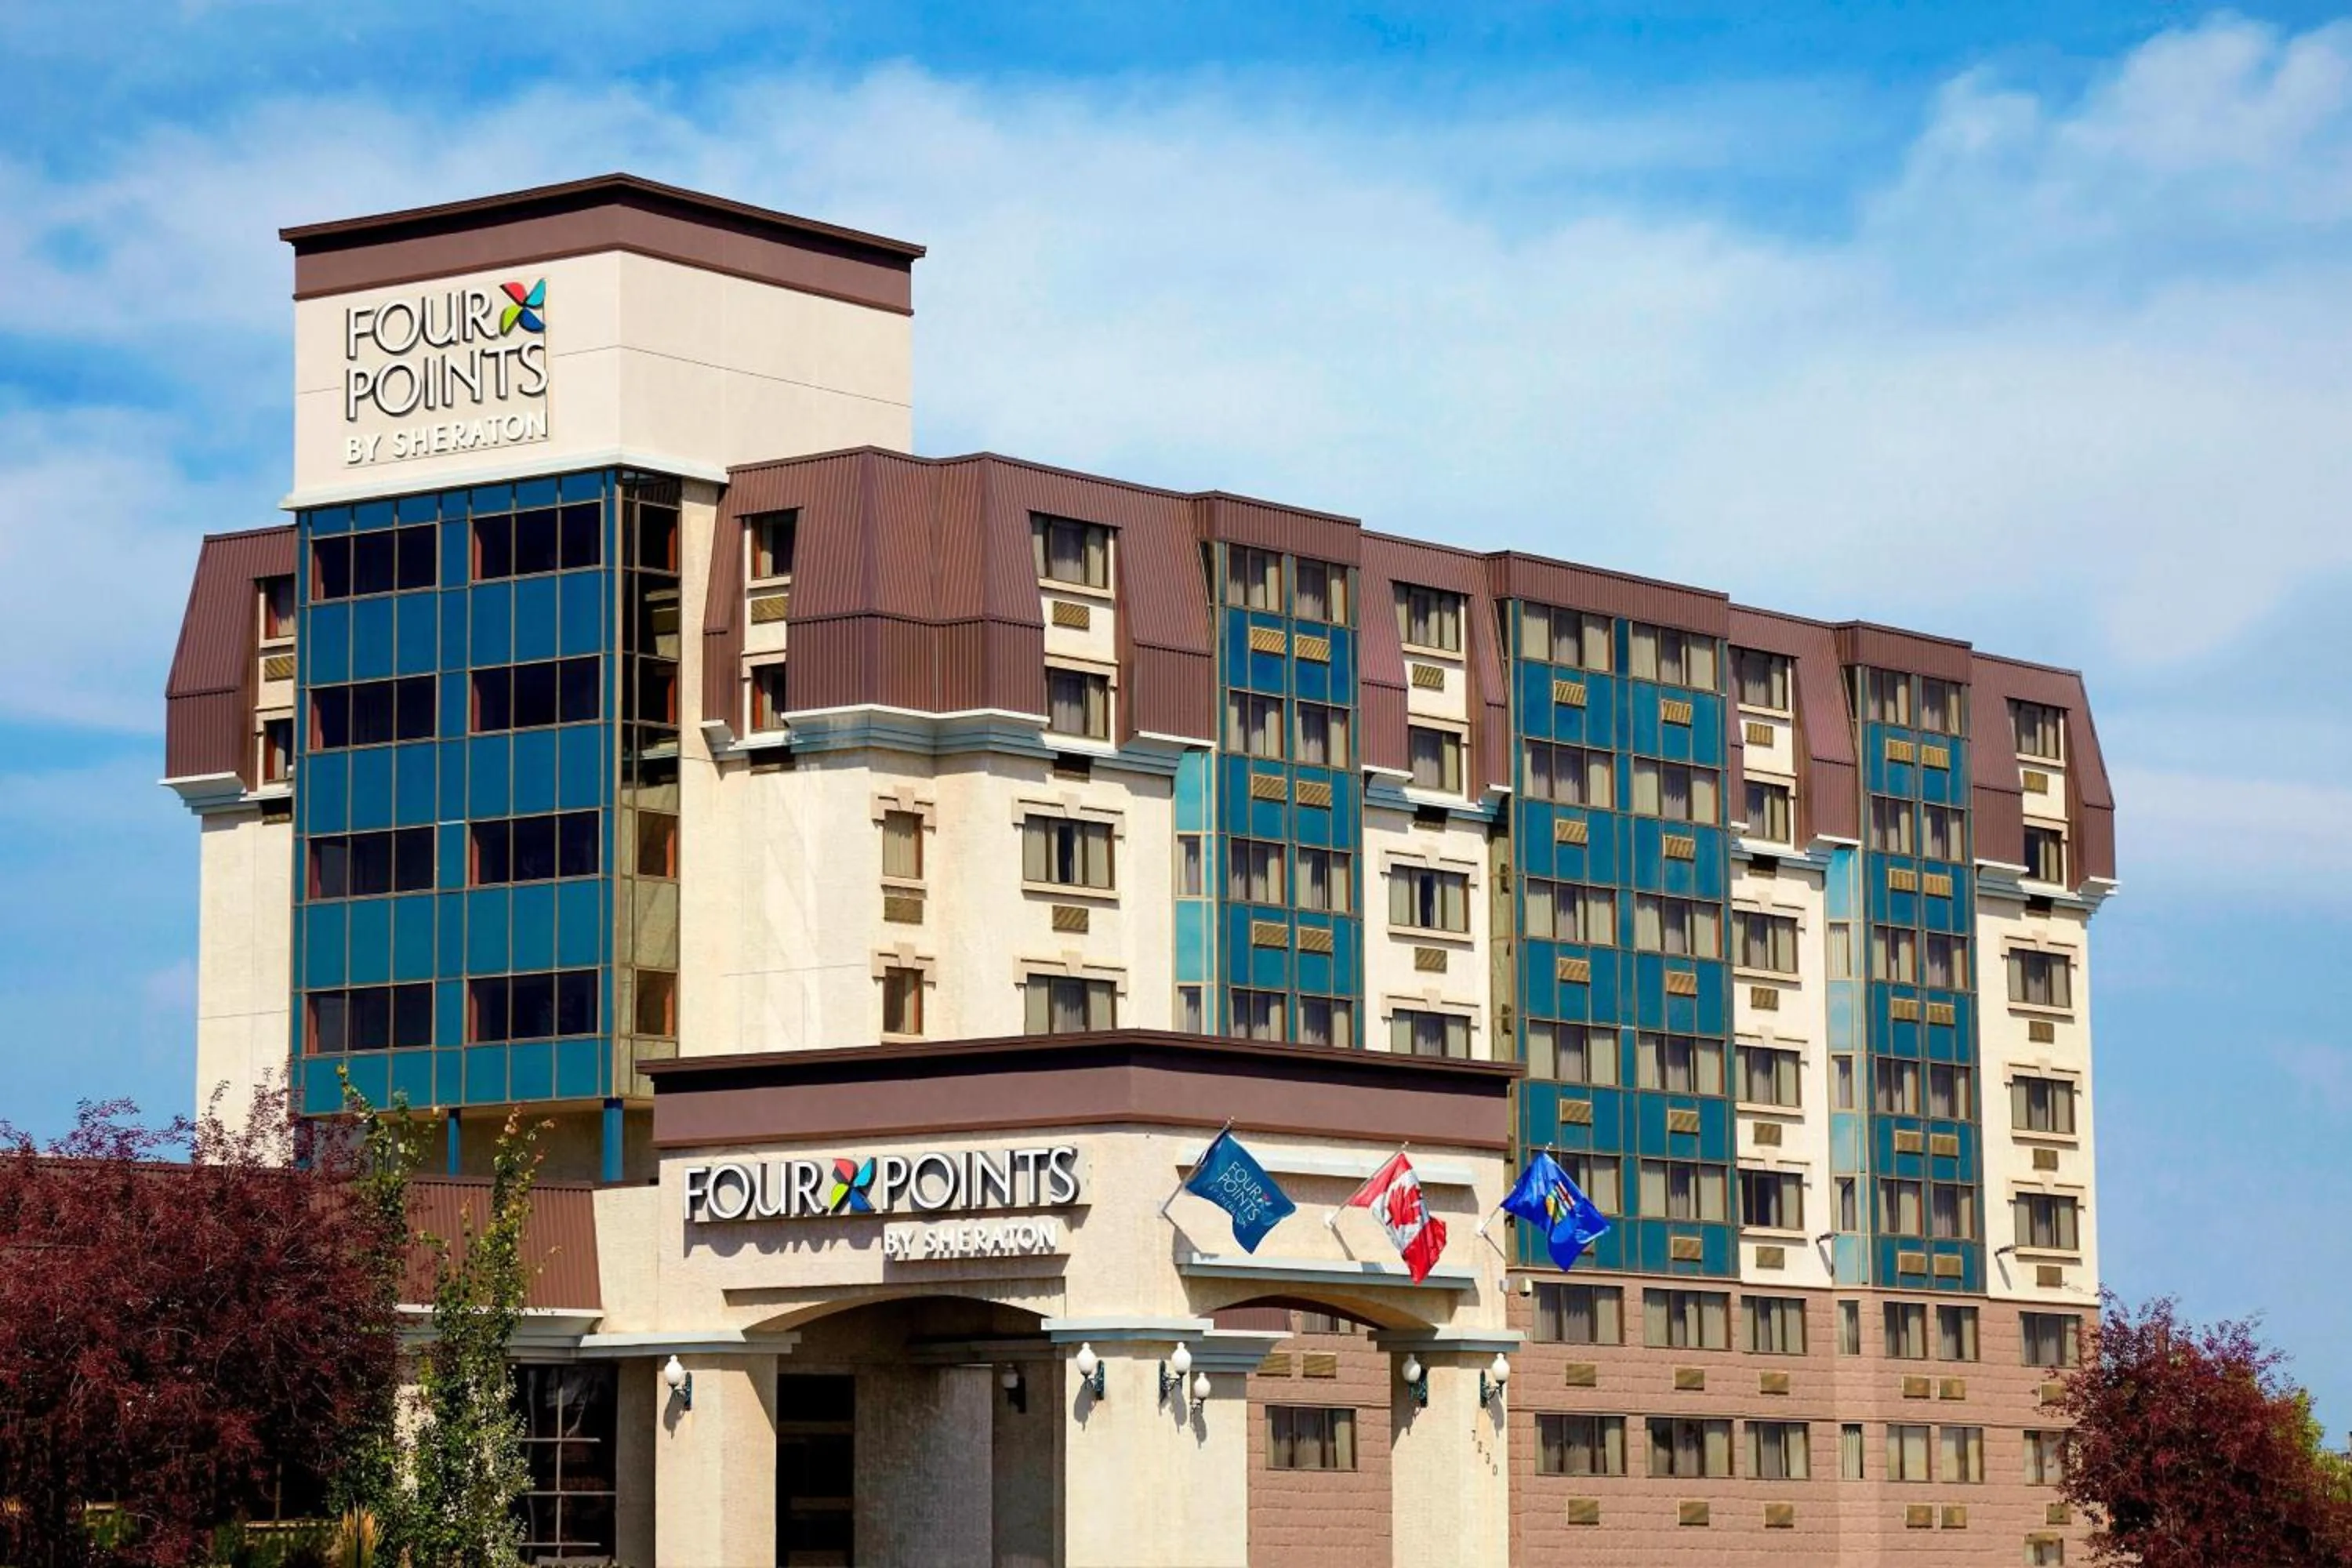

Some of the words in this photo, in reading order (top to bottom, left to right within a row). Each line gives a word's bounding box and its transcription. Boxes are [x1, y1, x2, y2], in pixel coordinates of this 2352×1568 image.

[346, 289, 499, 361] FOUR
[346, 339, 549, 422] POINTS
[345, 434, 382, 465] BY
[392, 410, 547, 459] SHERATON
[684, 1160, 829, 1221] FOUR
[882, 1145, 1079, 1212] POINTS
[1216, 1172, 1261, 1221] POINTS
[1227, 1161, 1262, 1201] FOUR
[884, 1229, 916, 1255] BY
[924, 1221, 1057, 1254] SHERATON
